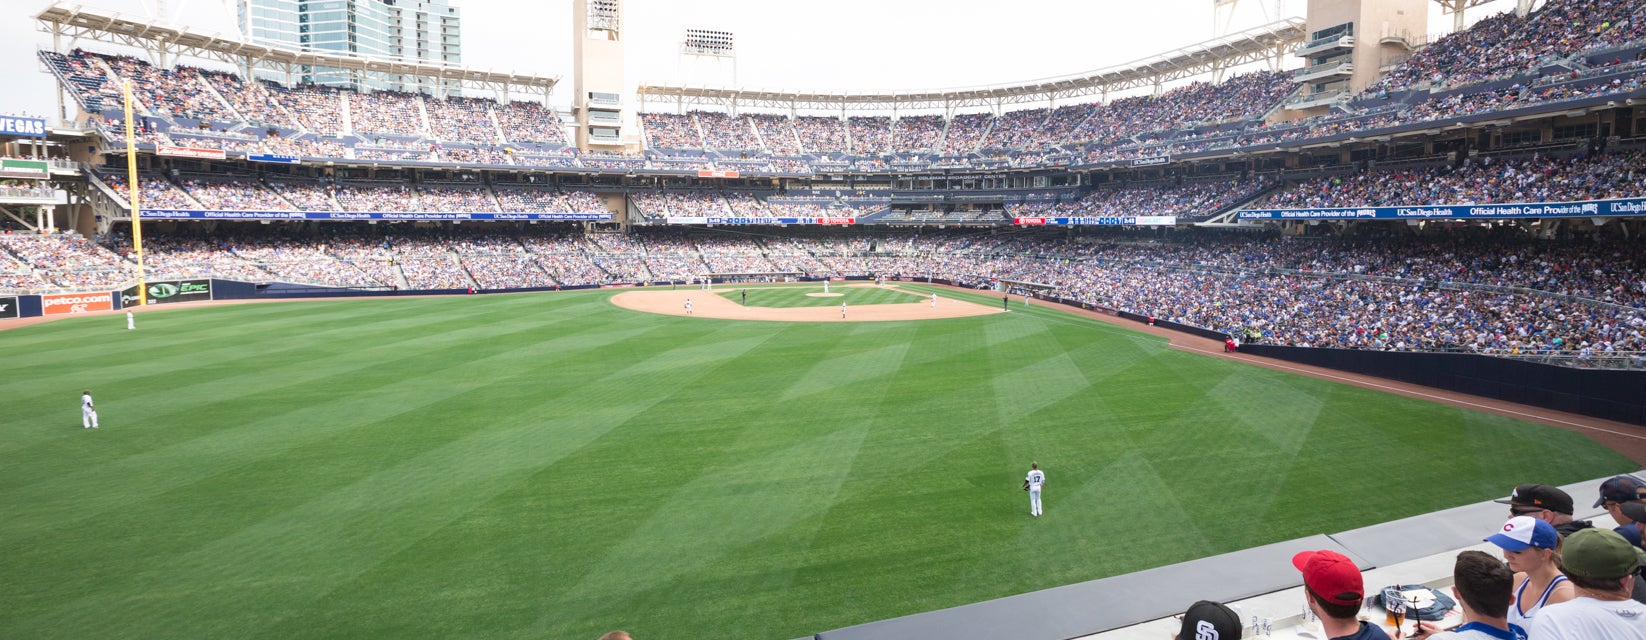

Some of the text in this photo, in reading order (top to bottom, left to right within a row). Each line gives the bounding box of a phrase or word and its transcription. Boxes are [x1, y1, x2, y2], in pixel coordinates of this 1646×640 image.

[1470, 207, 1495, 215] Official
[1544, 205, 1568, 214] Provider
[1611, 203, 1618, 212] UC
[1618, 203, 1627, 212] San
[1627, 202, 1641, 213] Diego
[1417, 209, 1433, 217] Diego
[180, 284, 208, 292] EPIC
[45, 295, 110, 307] petco.com
[1504, 523, 1514, 532] C
